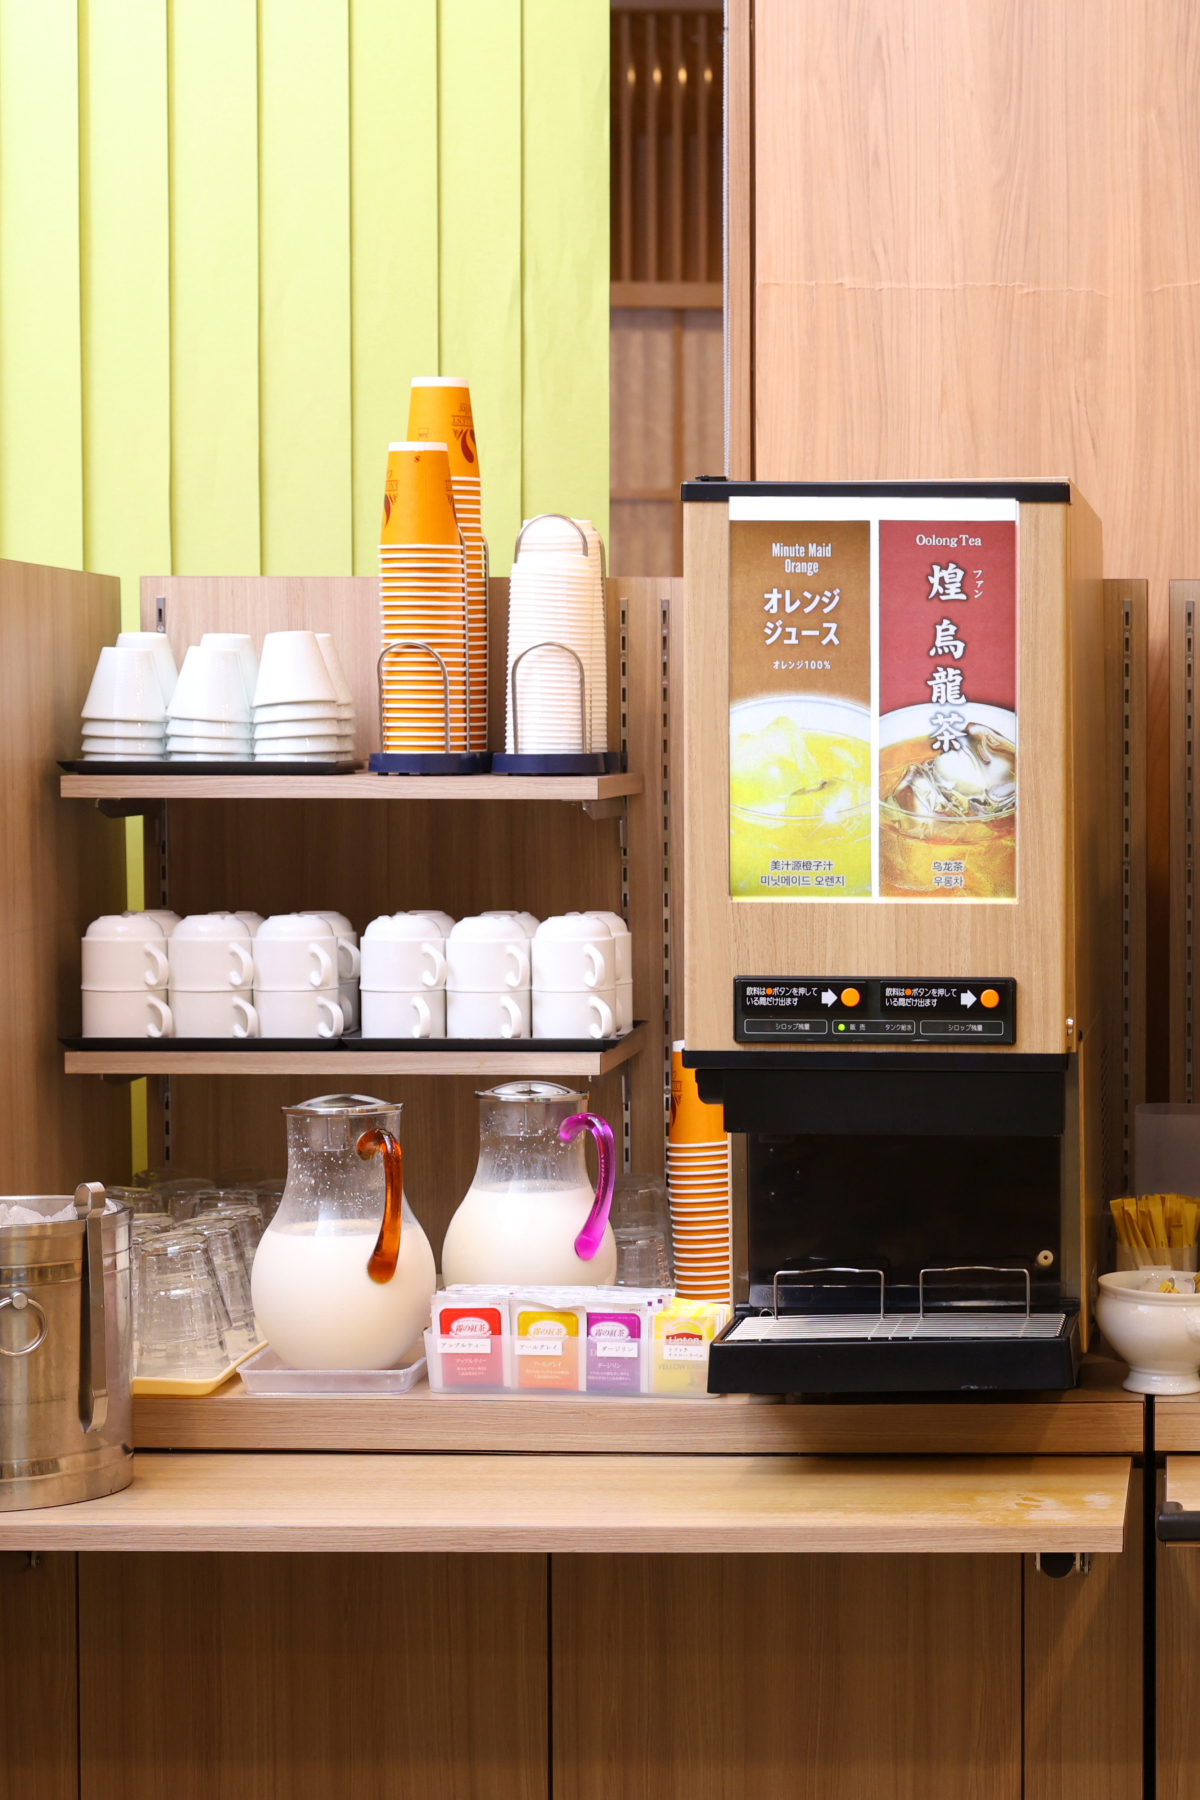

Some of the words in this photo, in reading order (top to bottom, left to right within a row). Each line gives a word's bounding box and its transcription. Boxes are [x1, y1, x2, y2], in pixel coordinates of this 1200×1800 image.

[916, 534, 958, 548] Oolong
[959, 534, 982, 546] Tea
[772, 543, 805, 558] Minute
[808, 543, 832, 558] Maid
[784, 559, 819, 576] Orange
[763, 588, 841, 614] オレンジ
[763, 620, 840, 646] ジュース
[772, 660, 831, 670] オレンジ100%
[770, 860, 834, 873] 美汁源橙子汁
[932, 861, 964, 873] 乌龙茶
[760, 876, 812, 887] 미닛메이드
[814, 876, 846, 888] 오렌지
[746, 997, 798, 1006] いる間だけ出ます
[886, 998, 938, 1007] いる間だけ出ます
[948, 1024, 983, 1032] シロップ残量
[456, 1324, 486, 1332] 霧の紅茶
[533, 1328, 563, 1336] 霧の紅茶
[595, 1329, 625, 1337] 霧の紅茶
[669, 1336, 700, 1345] Lipton
